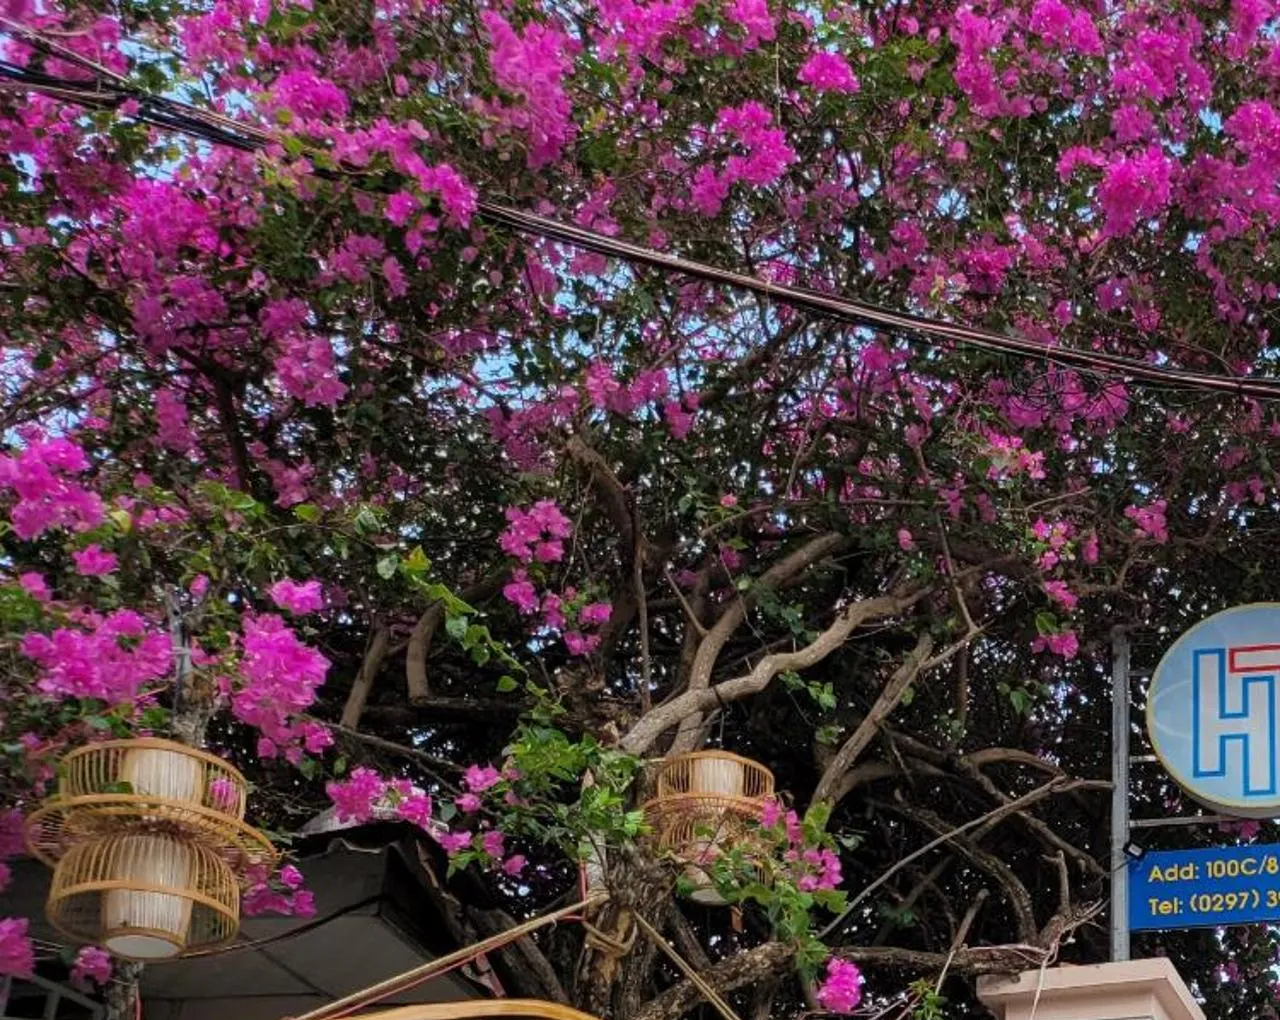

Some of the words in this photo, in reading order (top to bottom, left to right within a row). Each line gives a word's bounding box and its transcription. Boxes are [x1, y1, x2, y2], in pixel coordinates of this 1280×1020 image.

[1148, 865, 1199, 883] Add:
[1207, 855, 1279, 879] 100C/8
[1148, 897, 1183, 916] Tel:
[1189, 890, 1260, 913] (0297)
